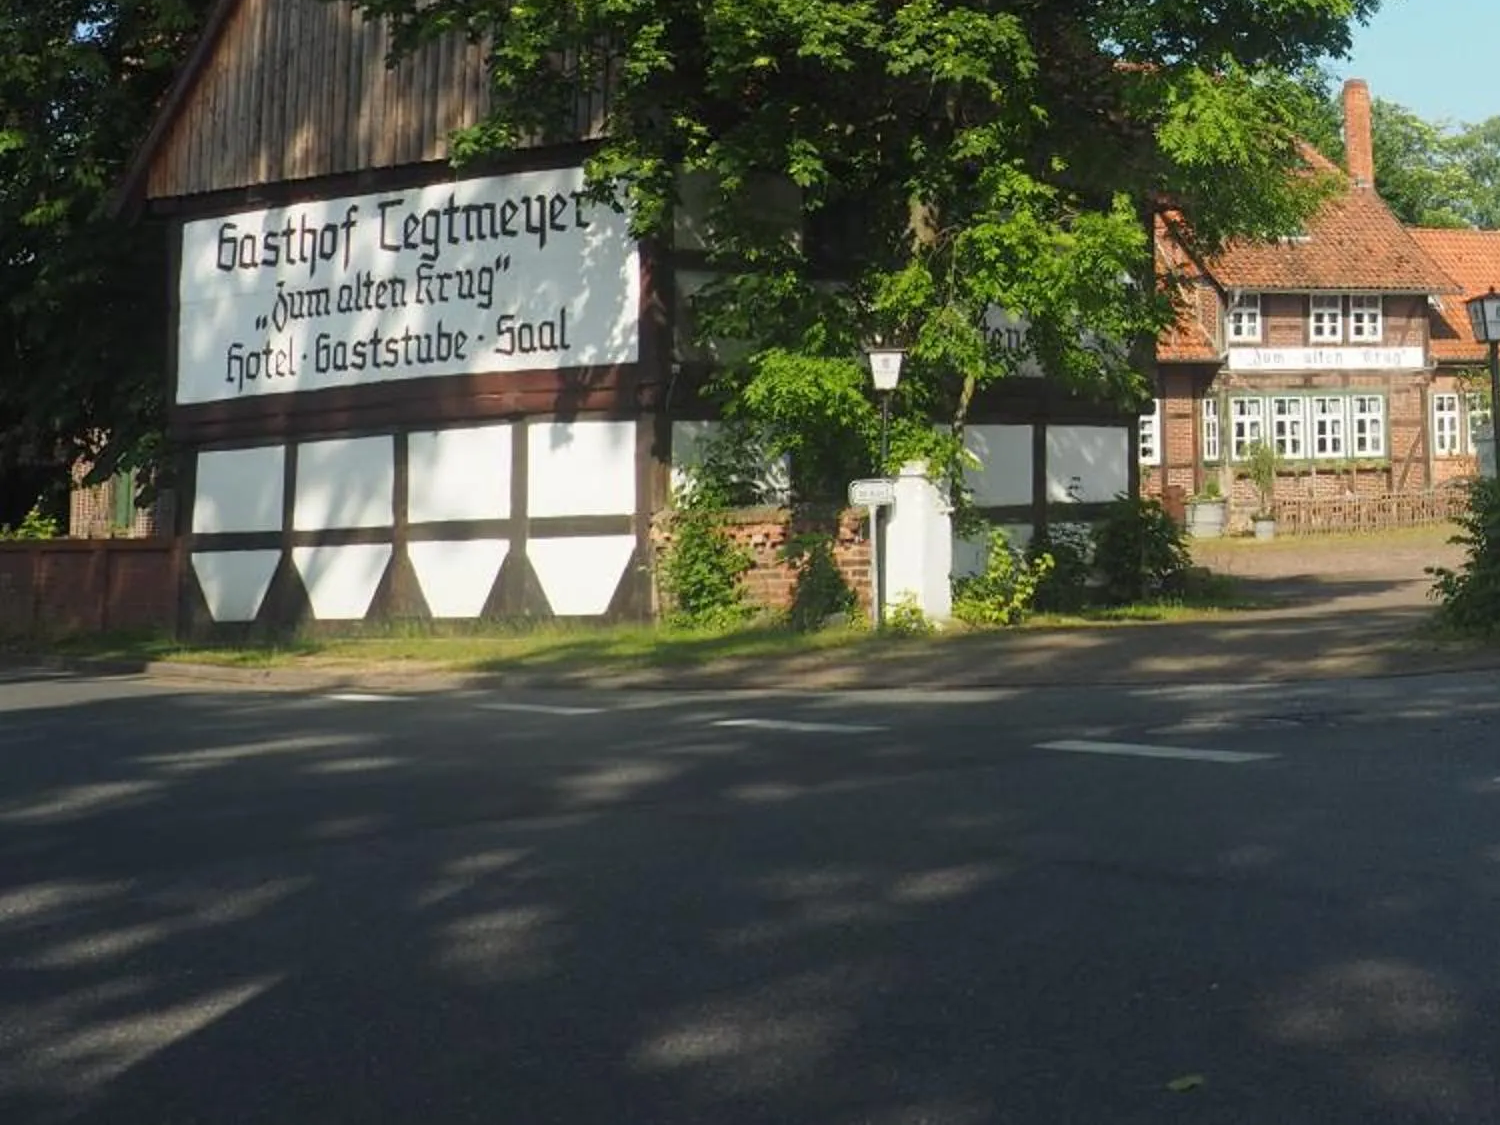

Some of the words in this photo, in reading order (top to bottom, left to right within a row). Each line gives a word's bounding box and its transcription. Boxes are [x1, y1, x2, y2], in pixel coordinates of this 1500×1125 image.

[217, 204, 359, 279] Gasthof
[377, 190, 592, 261] Tegtmeyer
[337, 271, 407, 313] alten
[226, 341, 296, 391] Hotel
[315, 320, 467, 375] Gaststube
[494, 306, 571, 356] Saal
